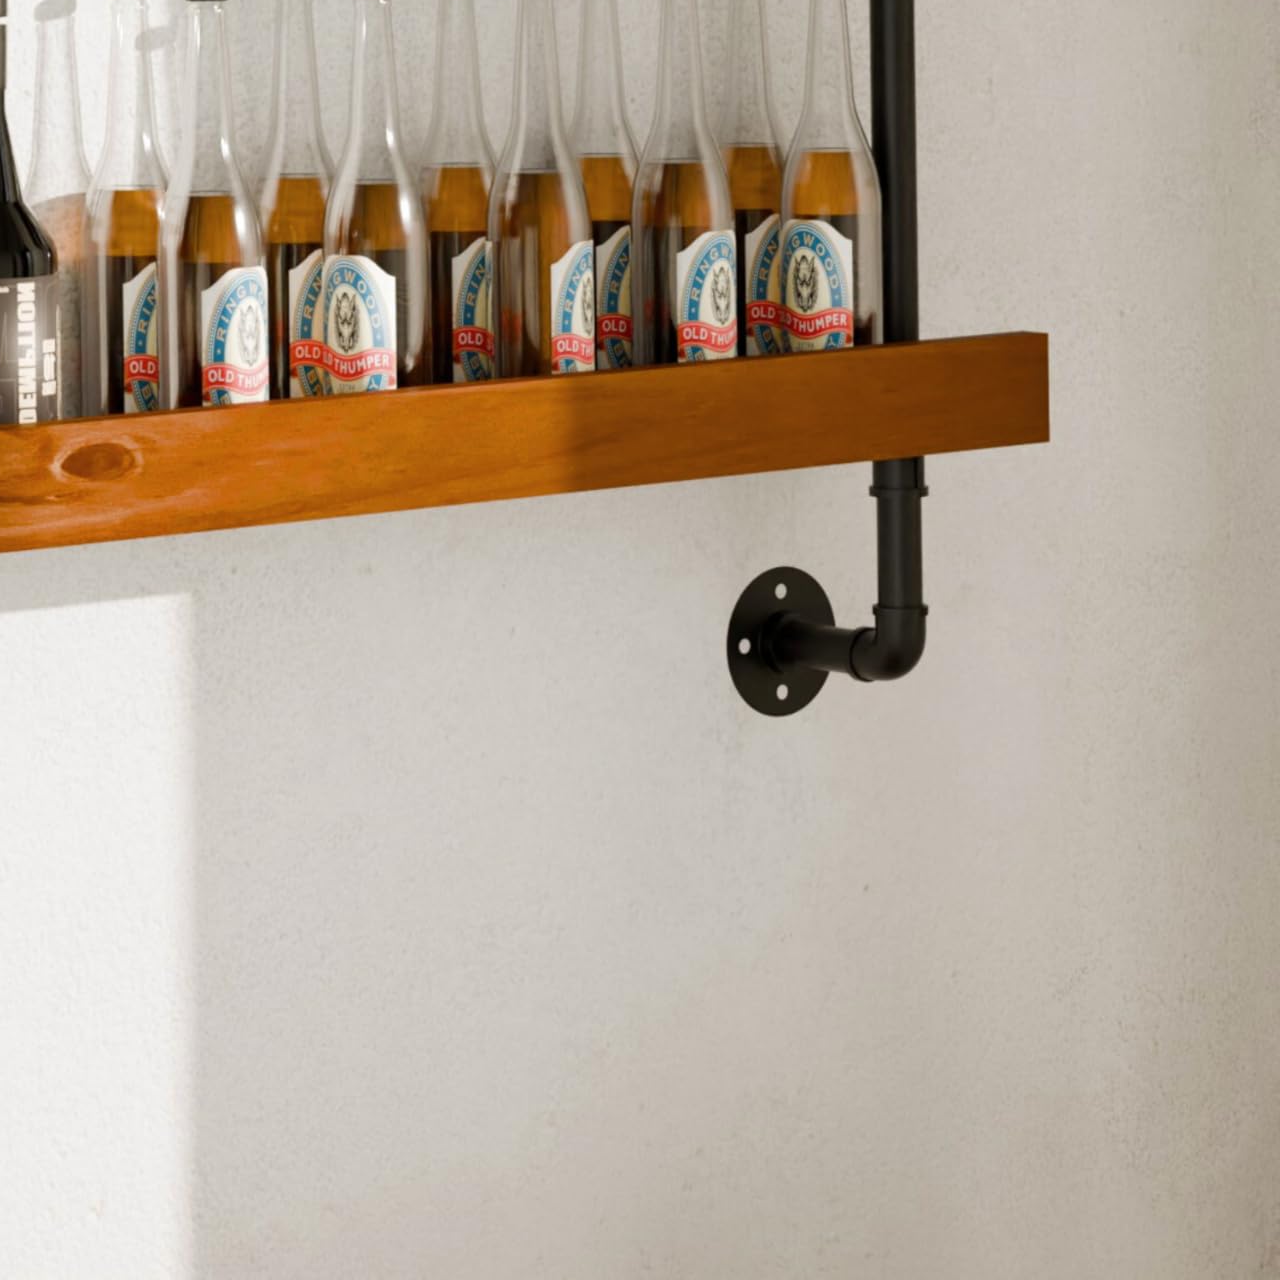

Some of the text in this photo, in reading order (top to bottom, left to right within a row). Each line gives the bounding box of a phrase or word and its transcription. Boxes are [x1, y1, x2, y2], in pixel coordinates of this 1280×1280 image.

[759, 239, 778, 280] RIN
[609, 253, 631, 294] RIN
[466, 264, 486, 307] RIN
[304, 278, 322, 319] RIN
[138, 294, 157, 334] RIN
[751, 306, 776, 319] OLD
[602, 320, 627, 333] OLD
[792, 313, 847, 332] THUMPER
[458, 332, 483, 346] OLD
[683, 327, 708, 340] OLD
[295, 346, 321, 359] OLD
[557, 340, 579, 352] OLD
[129, 361, 156, 374] OLD
[334, 354, 389, 373] THUMPER
[207, 369, 235, 383] OLD
